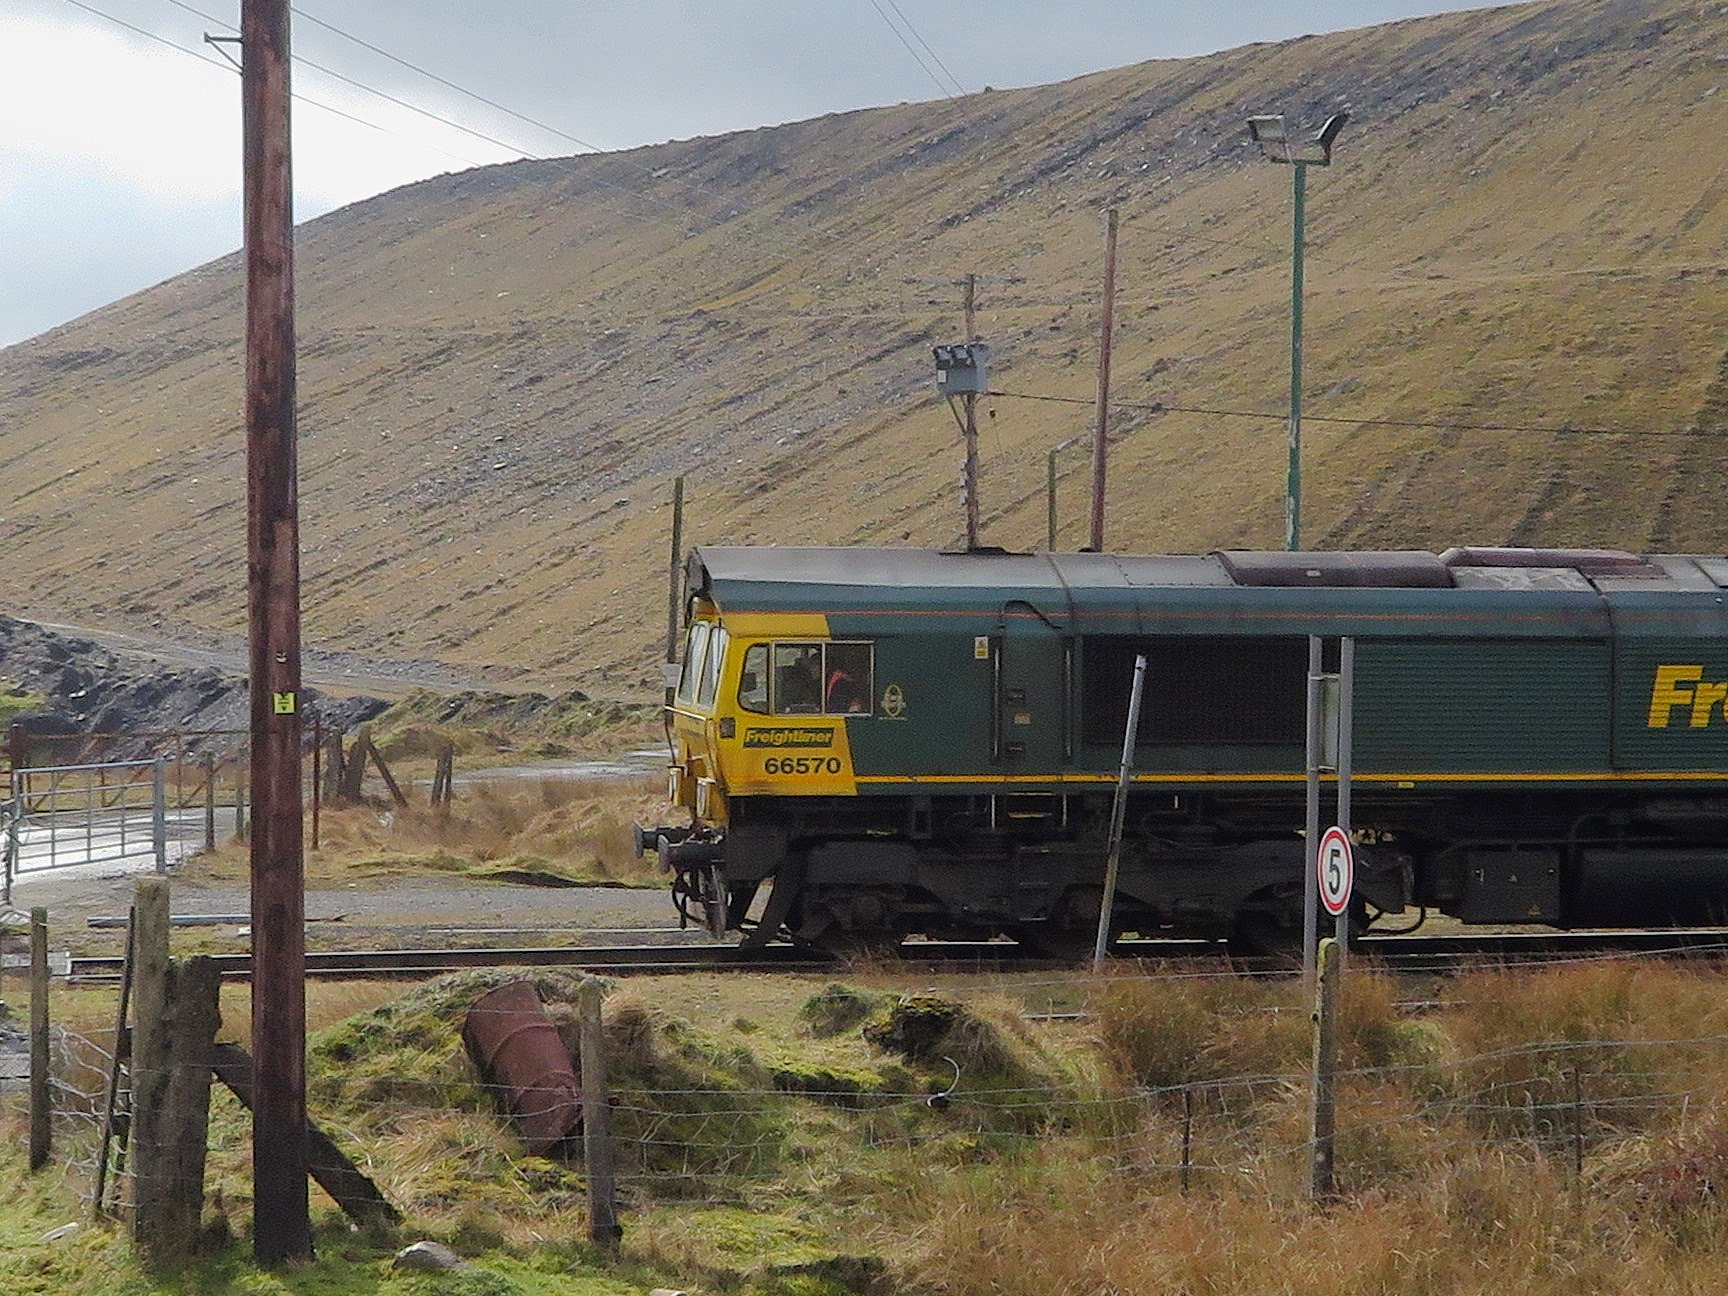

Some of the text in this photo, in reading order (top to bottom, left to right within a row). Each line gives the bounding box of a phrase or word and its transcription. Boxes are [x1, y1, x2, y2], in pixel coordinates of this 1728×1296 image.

[745, 729, 833, 745] Freightliner
[765, 757, 841, 774] 66570
[1329, 848, 1341, 895] 5
